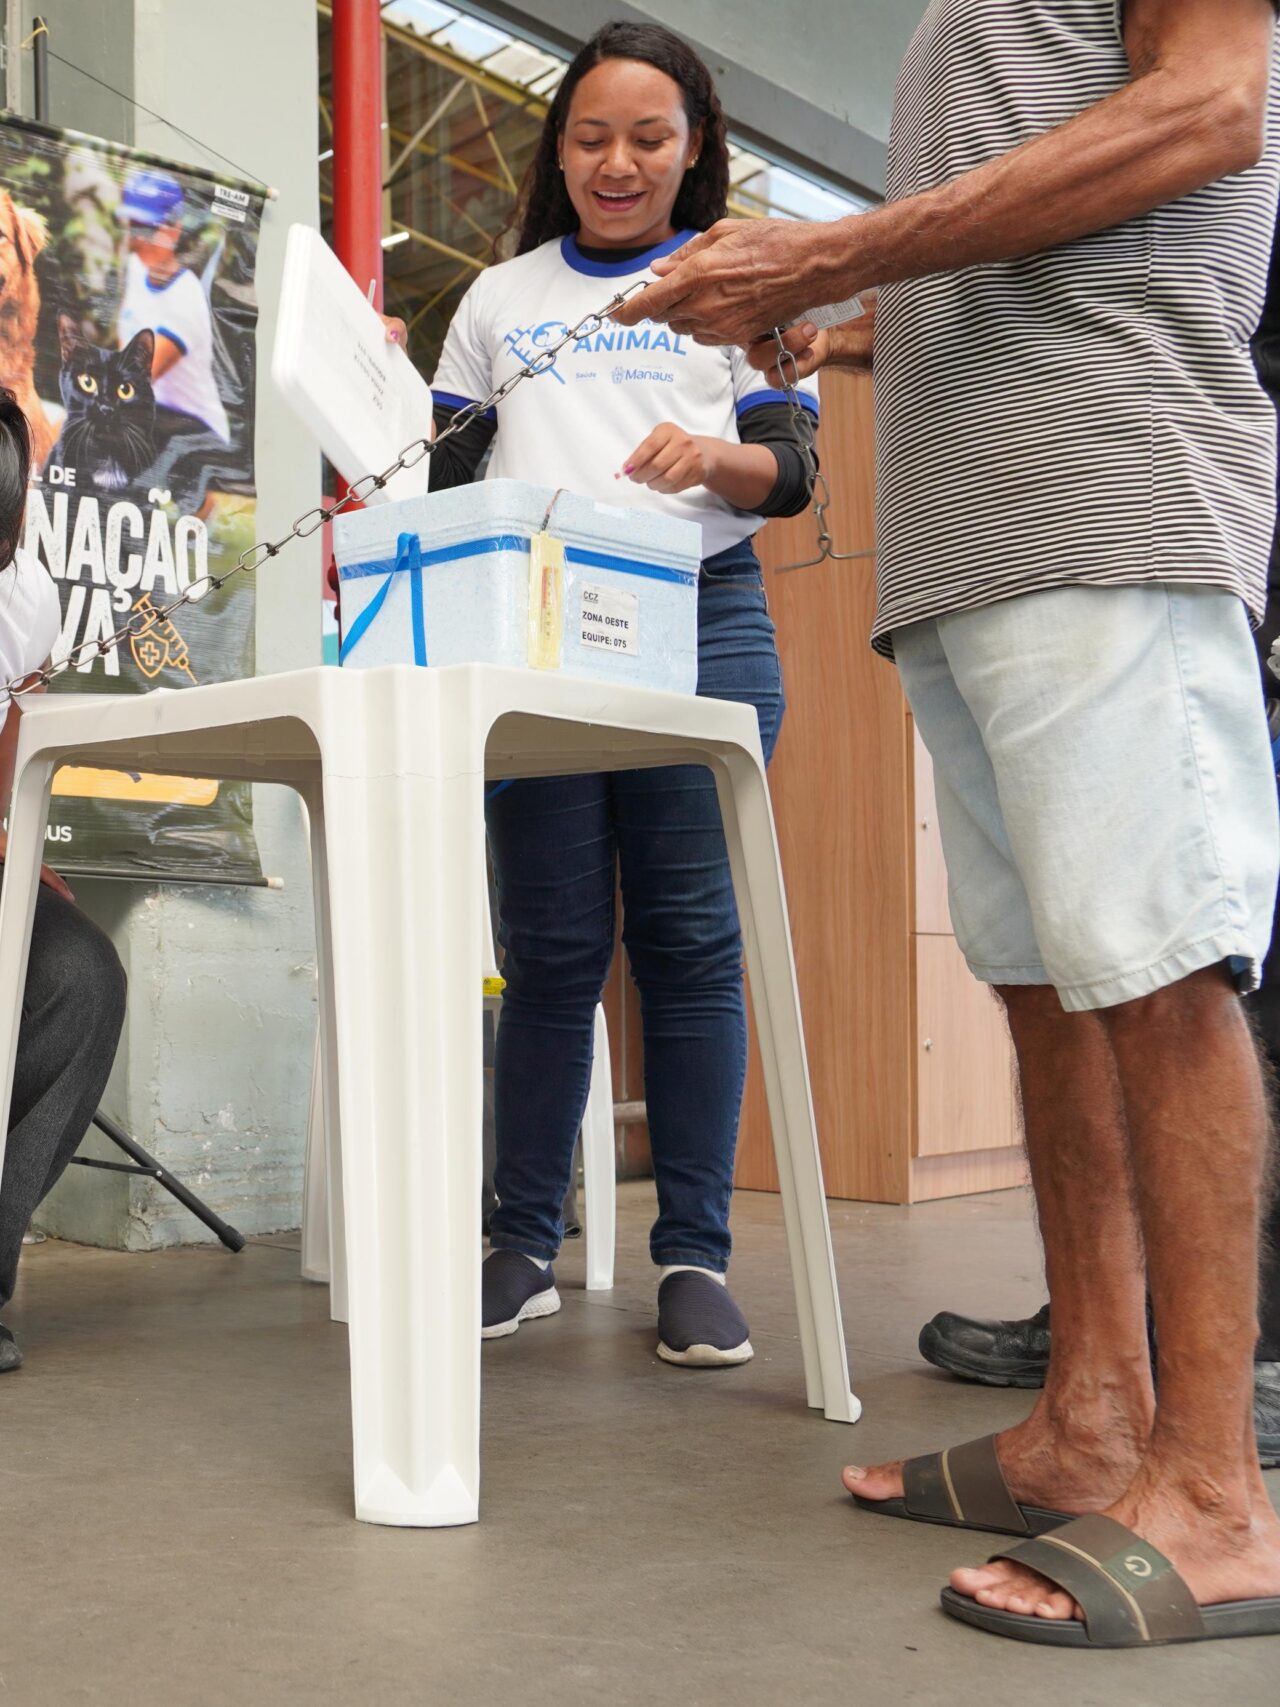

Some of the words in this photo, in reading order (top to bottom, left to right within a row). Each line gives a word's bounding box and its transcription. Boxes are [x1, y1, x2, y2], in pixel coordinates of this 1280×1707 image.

[572, 330, 686, 356] ANIMAL
[576, 371, 597, 379] Saúde
[625, 369, 674, 382] Manaus
[49, 465, 76, 486] DE
[584, 591, 598, 602] CCZ
[582, 611, 603, 623] ZONA
[605, 616, 629, 629] OESTE
[582, 632, 612, 645] EQUIPE:
[614, 639, 627, 648] 075
[44, 825, 72, 842] US
